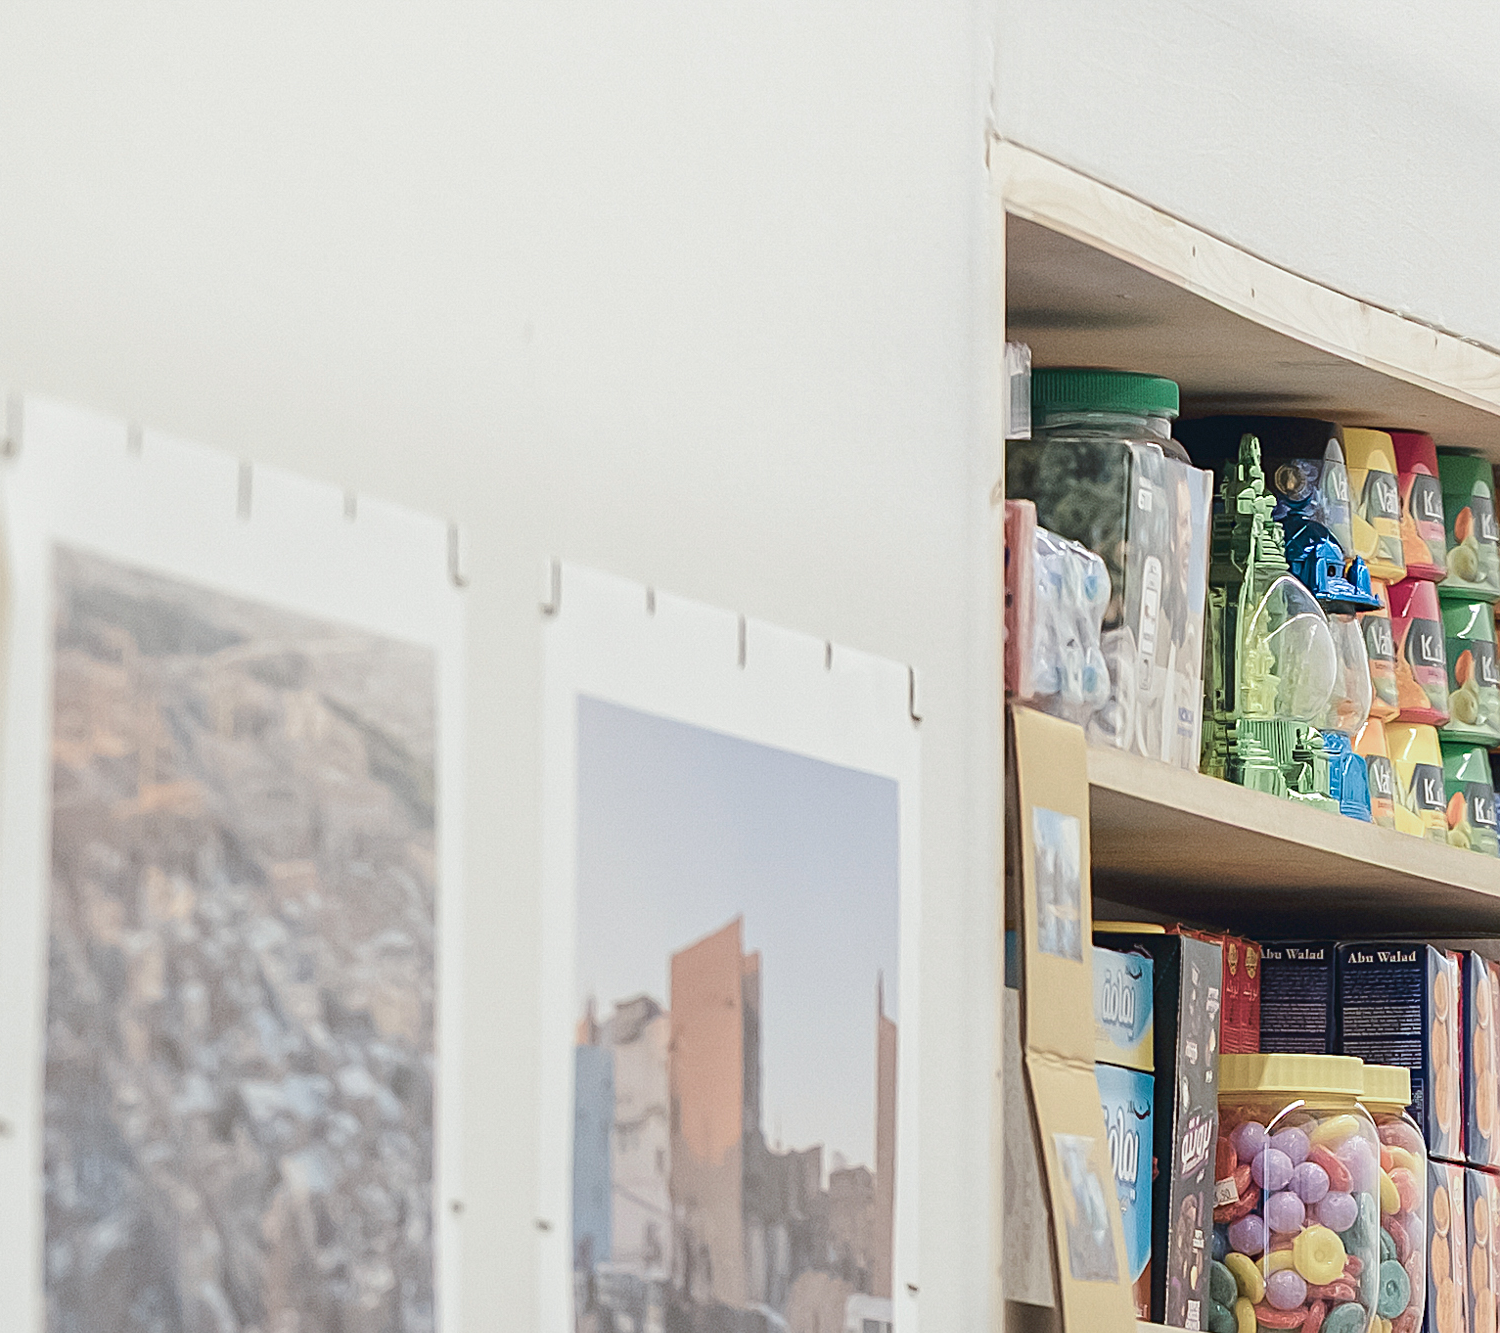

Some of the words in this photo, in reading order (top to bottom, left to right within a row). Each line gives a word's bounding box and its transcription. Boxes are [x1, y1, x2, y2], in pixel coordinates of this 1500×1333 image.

[1285, 948, 1325, 960] Walad
[1347, 952, 1374, 964] Abu
[1376, 950, 1417, 963] Walad
[1102, 1104, 1140, 1204] يمام
